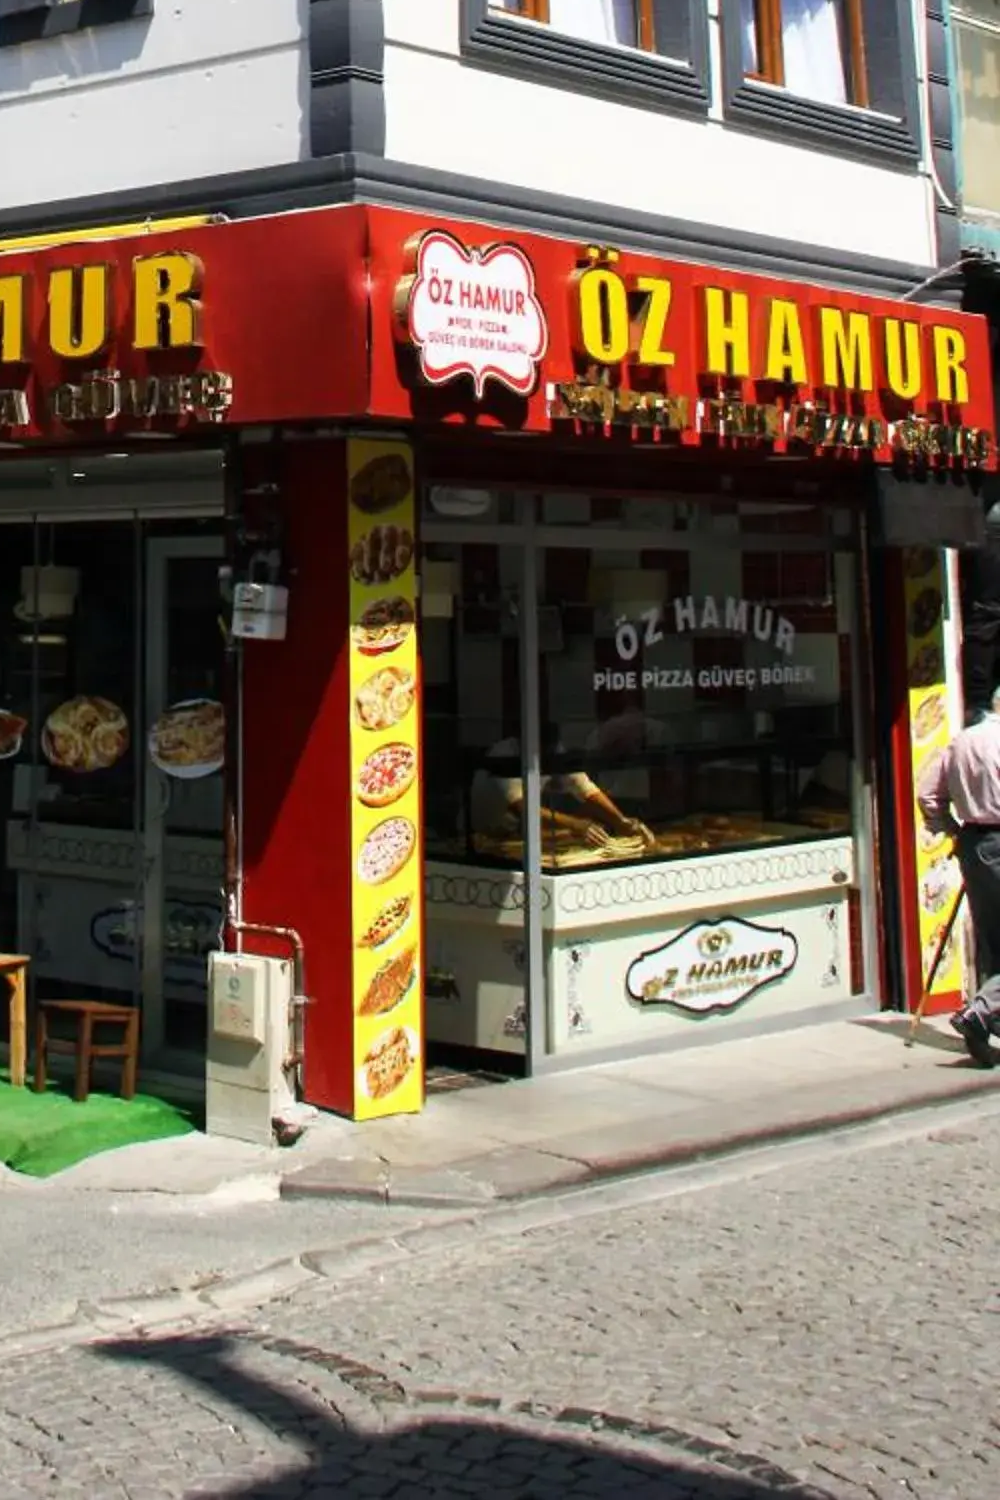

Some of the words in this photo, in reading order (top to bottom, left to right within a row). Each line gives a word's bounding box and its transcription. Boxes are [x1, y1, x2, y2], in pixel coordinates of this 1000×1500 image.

[428, 268, 453, 305] ÖZ
[459, 281, 526, 317] HAMUR
[578, 245, 675, 366] ÖZ
[704, 287, 969, 403] HAMUR
[615, 607, 664, 661] ÖZ
[673, 595, 796, 656] HAMUR
[593, 666, 637, 692] PİDE
[641, 665, 694, 688] PİZZA
[698, 664, 757, 691] GÜVEÇ
[686, 948, 785, 984] HAMUR
